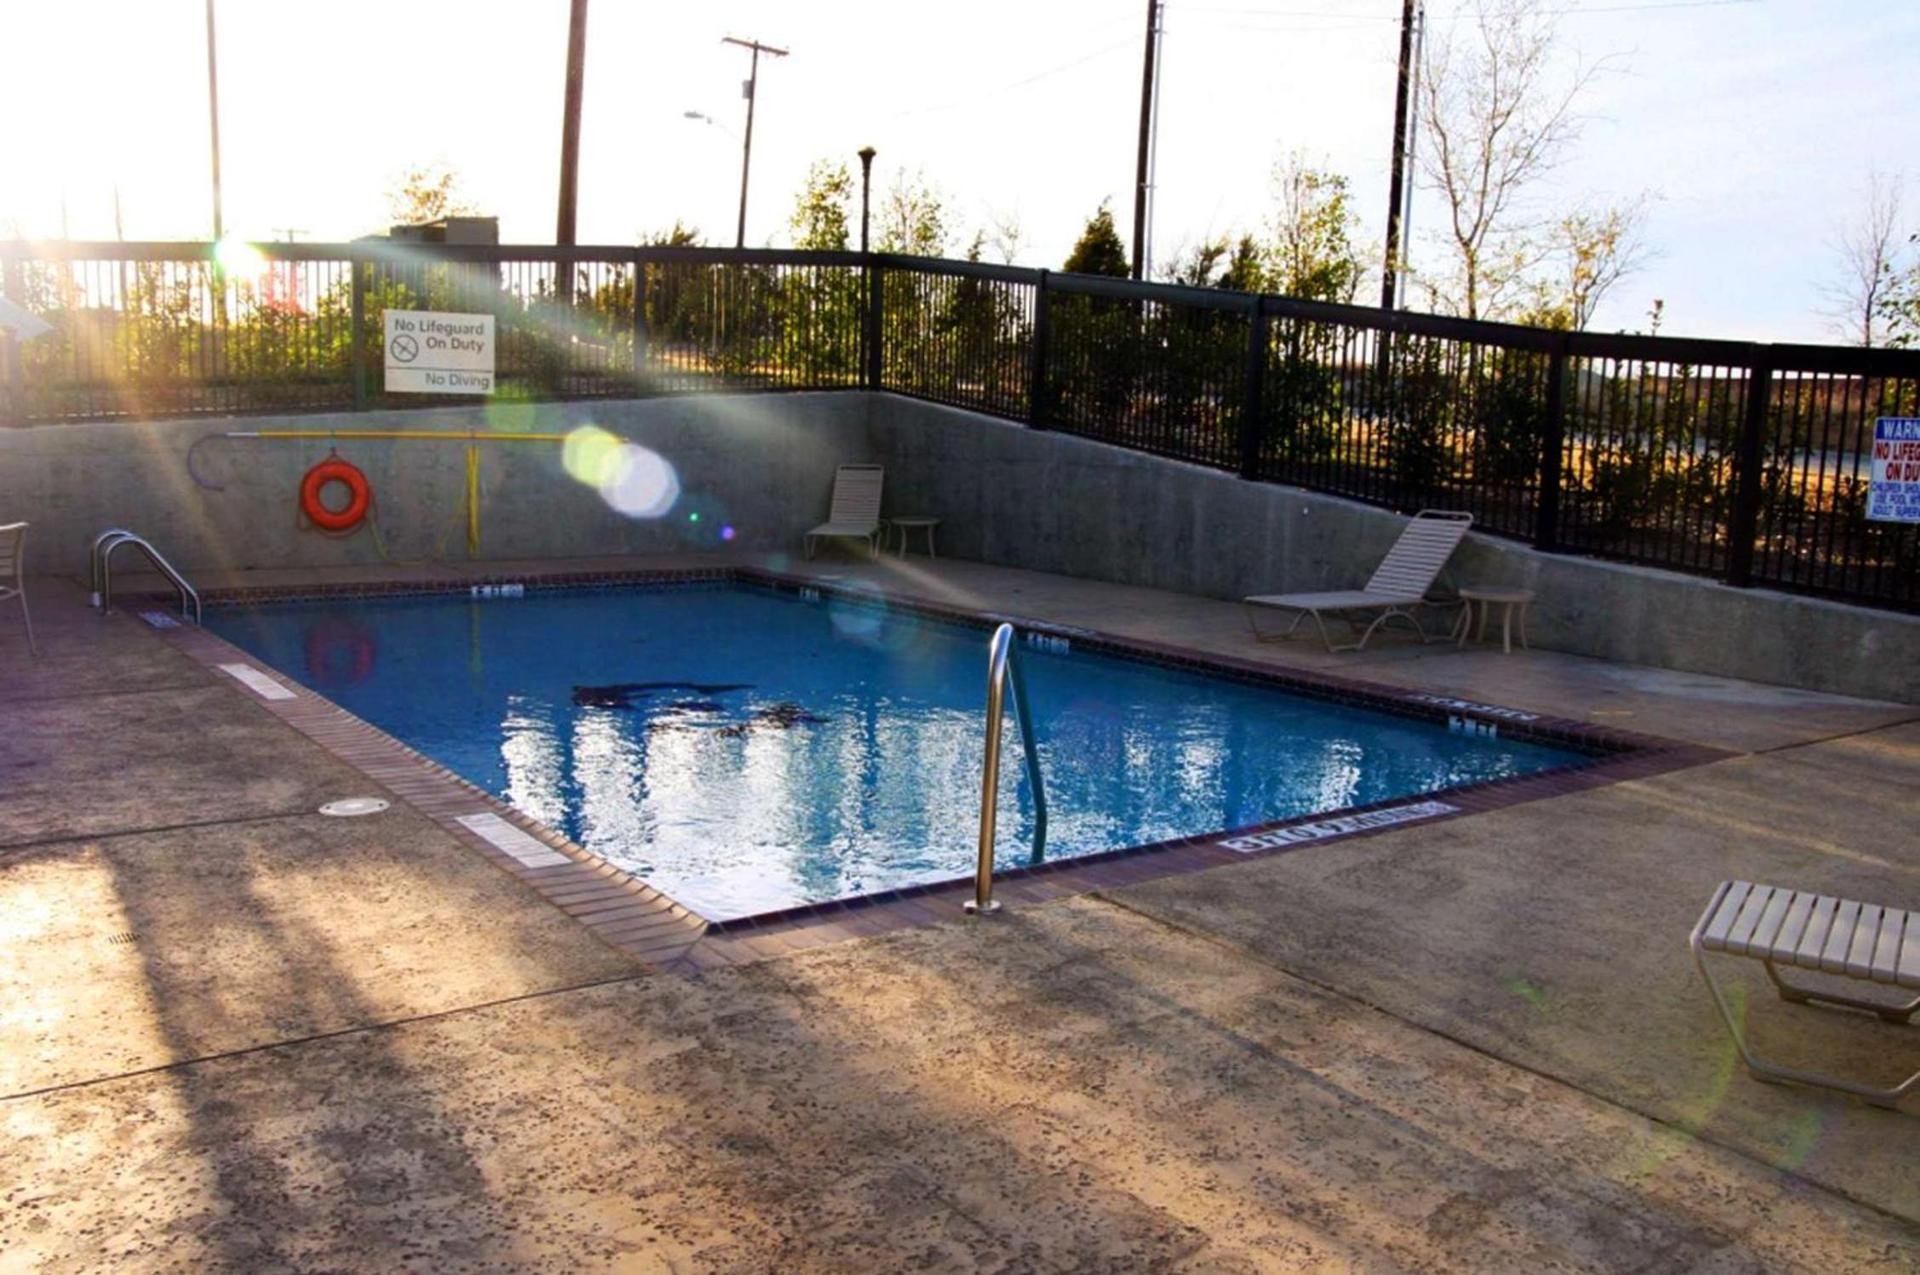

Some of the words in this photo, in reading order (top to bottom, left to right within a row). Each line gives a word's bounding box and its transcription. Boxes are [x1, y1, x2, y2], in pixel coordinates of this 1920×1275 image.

[395, 319, 415, 331] No
[420, 320, 484, 337] Lifeguard
[426, 336, 447, 349] On
[450, 337, 485, 353] Duty
[425, 373, 446, 385] No
[449, 373, 490, 391] Diving
[1875, 442, 1889, 460] NO
[1885, 462, 1902, 480] ON
